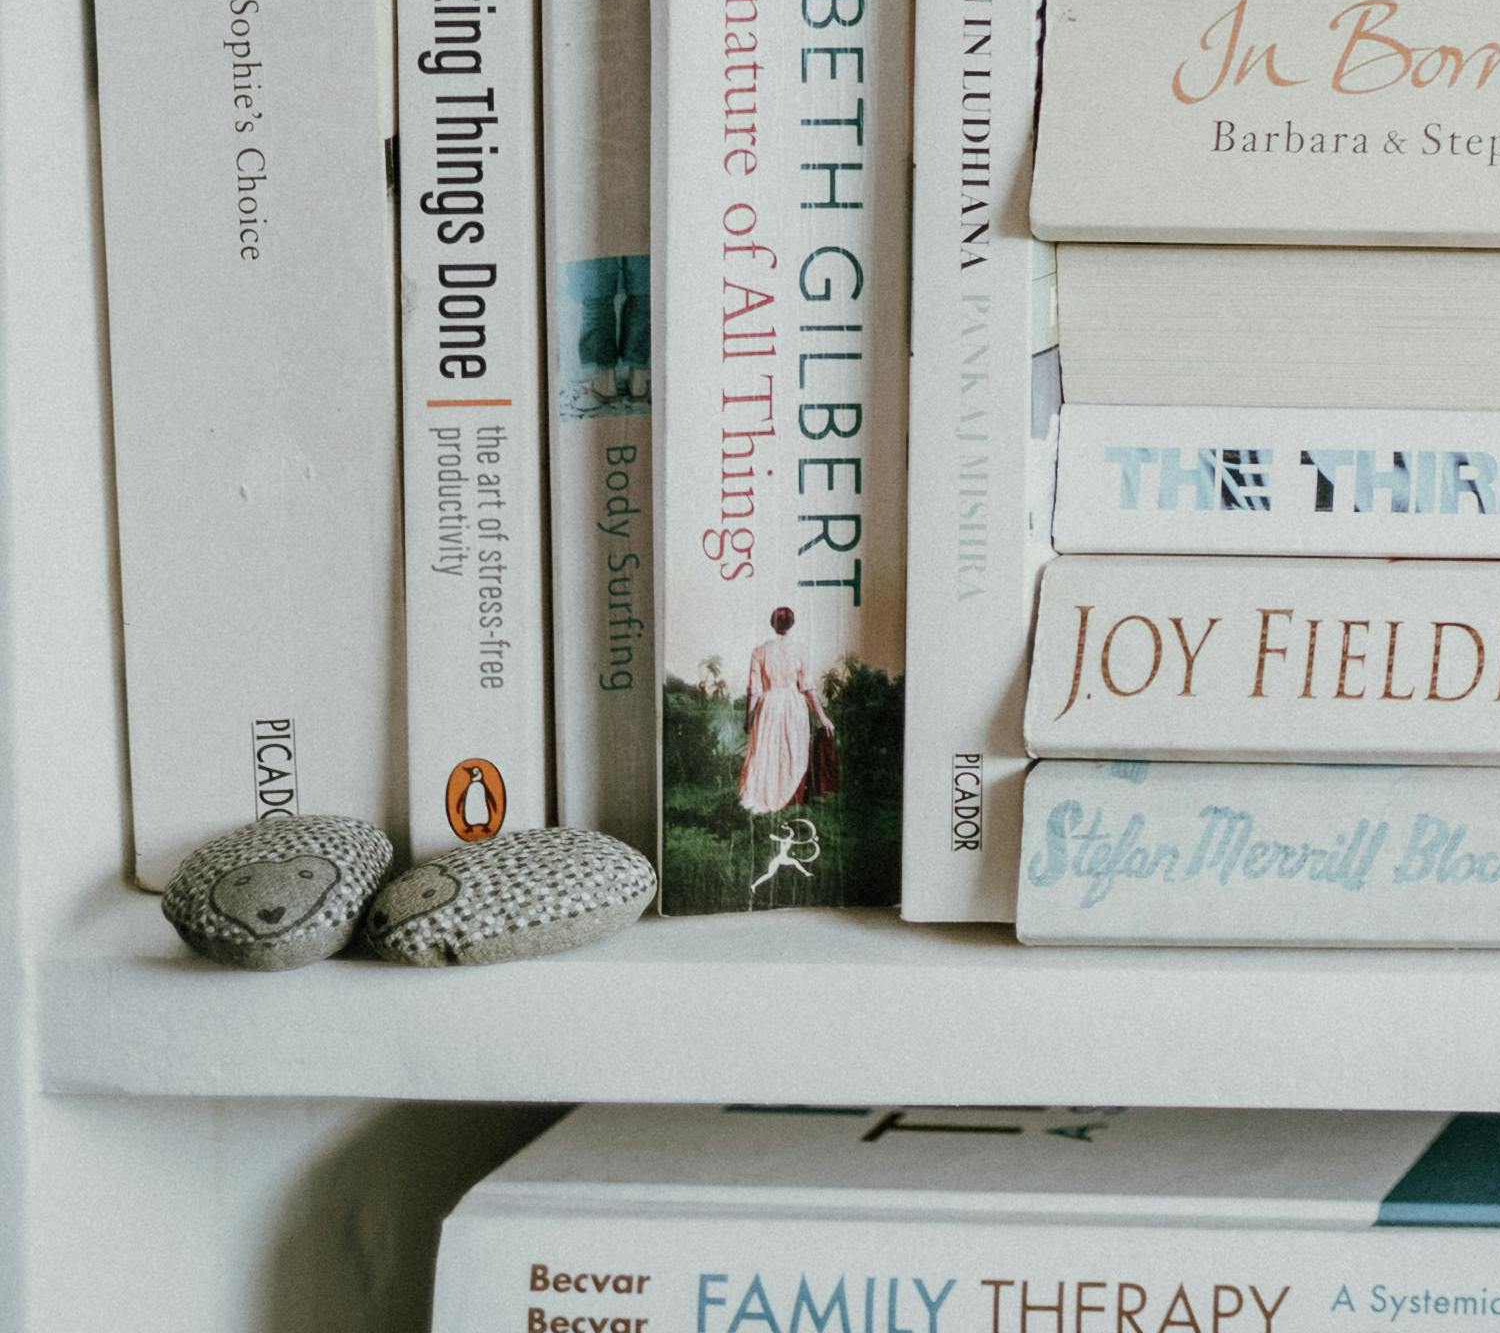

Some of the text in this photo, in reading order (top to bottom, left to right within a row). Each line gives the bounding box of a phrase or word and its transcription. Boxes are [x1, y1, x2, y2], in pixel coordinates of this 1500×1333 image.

[962, 17, 994, 56] IN
[419, 86, 500, 245] Things
[958, 68, 992, 271] LUDHIANA
[1211, 119, 1370, 156] Barbara
[1384, 128, 1409, 156] &
[236, 147, 268, 262] Choice
[437, 261, 498, 381] Done
[797, 245, 864, 608] GILBERT
[954, 752, 980, 853] PICADOR
[528, 1263, 652, 1297] Becvar
[696, 1273, 1293, 1333] FAMILY THERAPY
[1330, 1284, 1355, 1315] A
